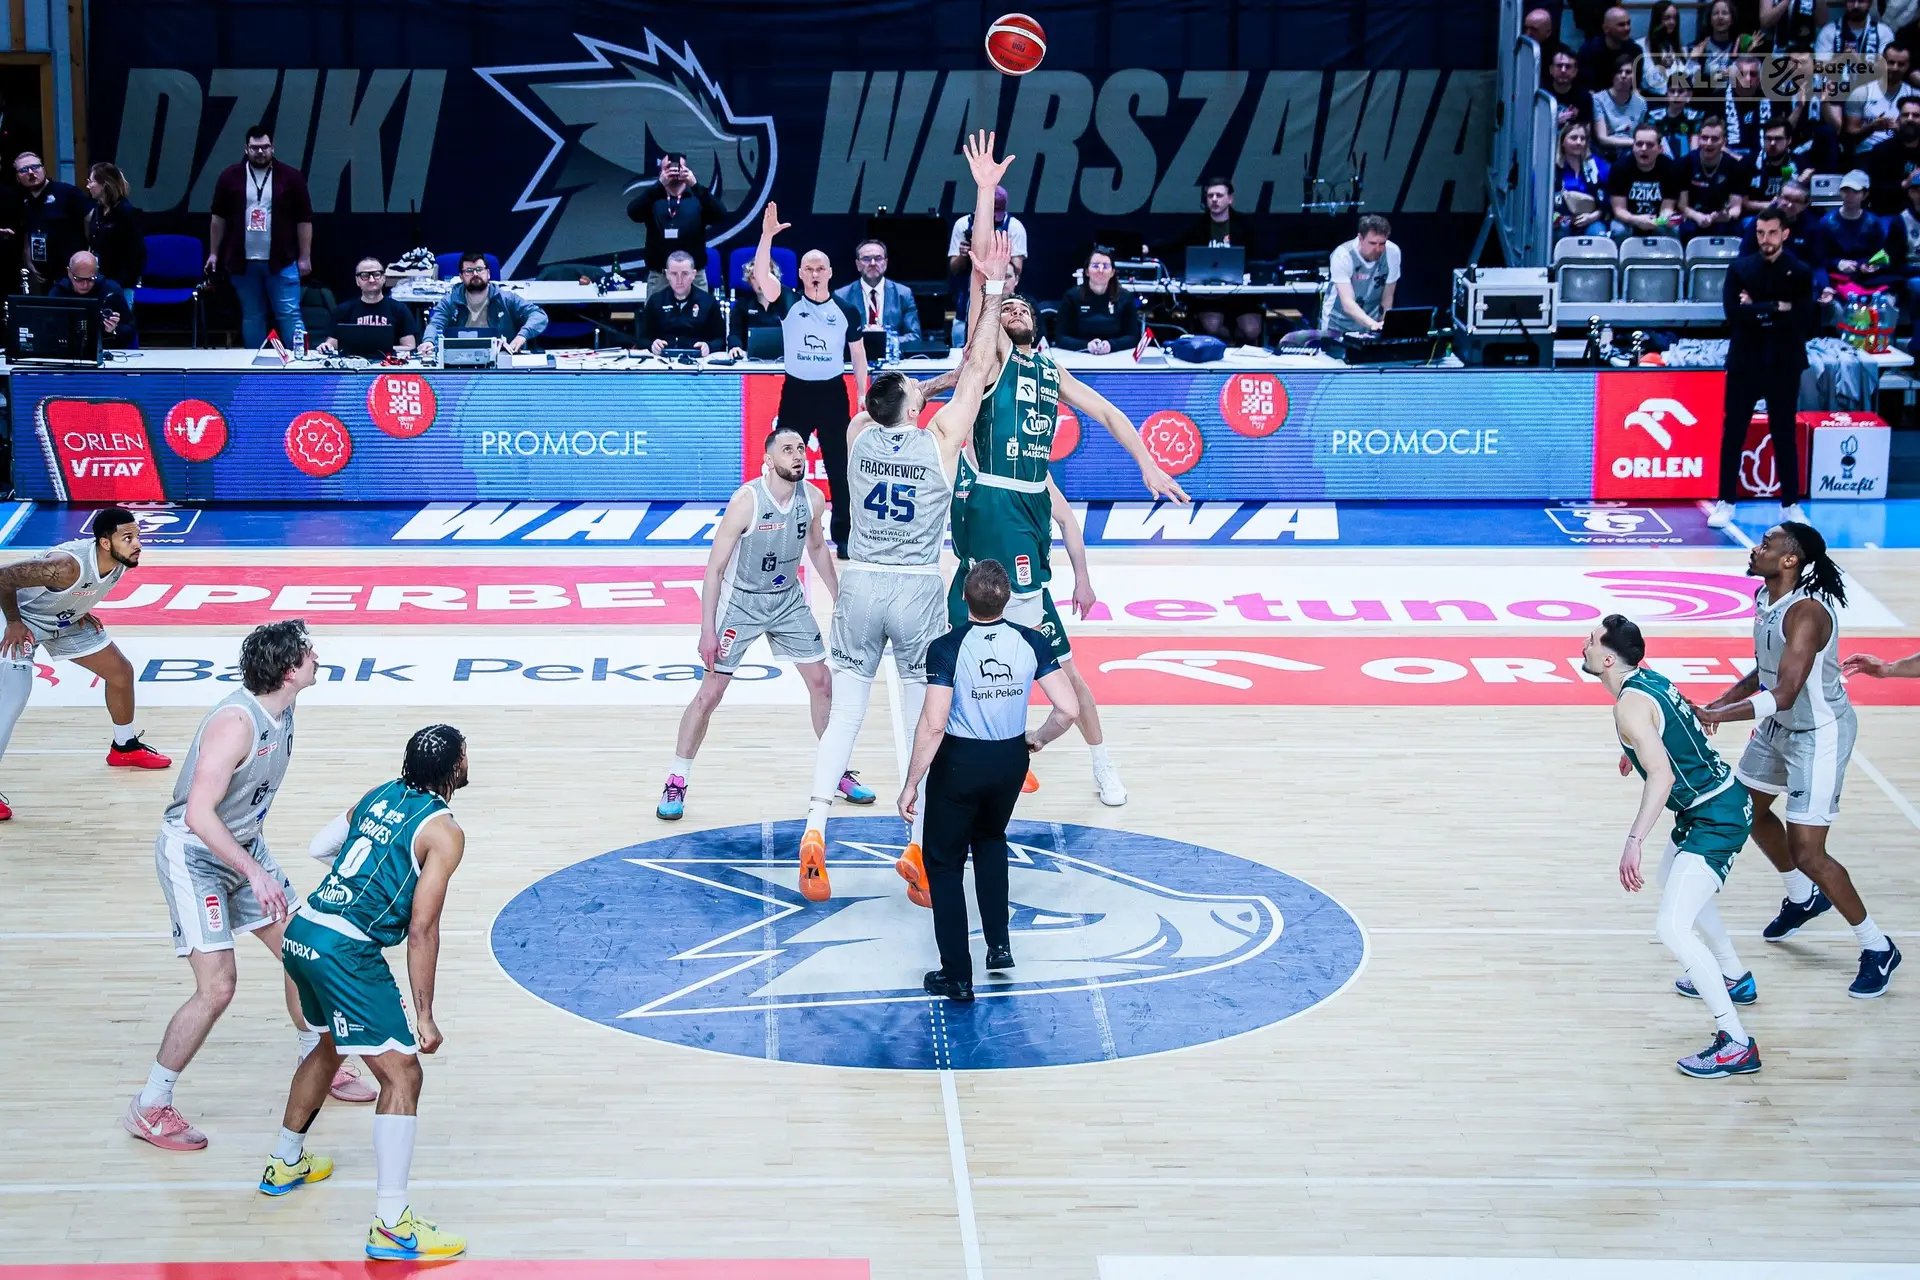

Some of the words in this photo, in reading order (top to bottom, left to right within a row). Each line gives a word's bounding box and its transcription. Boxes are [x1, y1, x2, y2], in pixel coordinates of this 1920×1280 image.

[113, 68, 447, 213] DZIKI
[811, 69, 1497, 214] WARSZAWA
[797, 353, 811, 361] Bank
[813, 354, 832, 362] Pekao
[63, 432, 145, 452] ORLEN
[481, 430, 649, 456] PROMOCJE
[891, 434, 904, 442] 4F
[1332, 429, 1500, 455] PROMOCJE
[860, 459, 927, 481] FRĄCKIEWICZ
[1611, 456, 1704, 479] ORLEN
[1818, 475, 1876, 496] Maczfit
[863, 481, 917, 523] 45
[762, 512, 774, 520] 4F
[797, 522, 807, 540] 5
[869, 528, 911, 538] VOLKSWAGEN
[91, 579, 706, 612] UPERBE
[984, 633, 997, 641] 4F
[1050, 636, 1062, 646] 4F
[1766, 630, 1771, 650] 1
[452, 656, 783, 682] Pekao
[971, 690, 993, 701] Bank
[995, 688, 1024, 698] Pekao
[1789, 790, 1805, 798] 4F
[337, 835, 373, 879] 0
